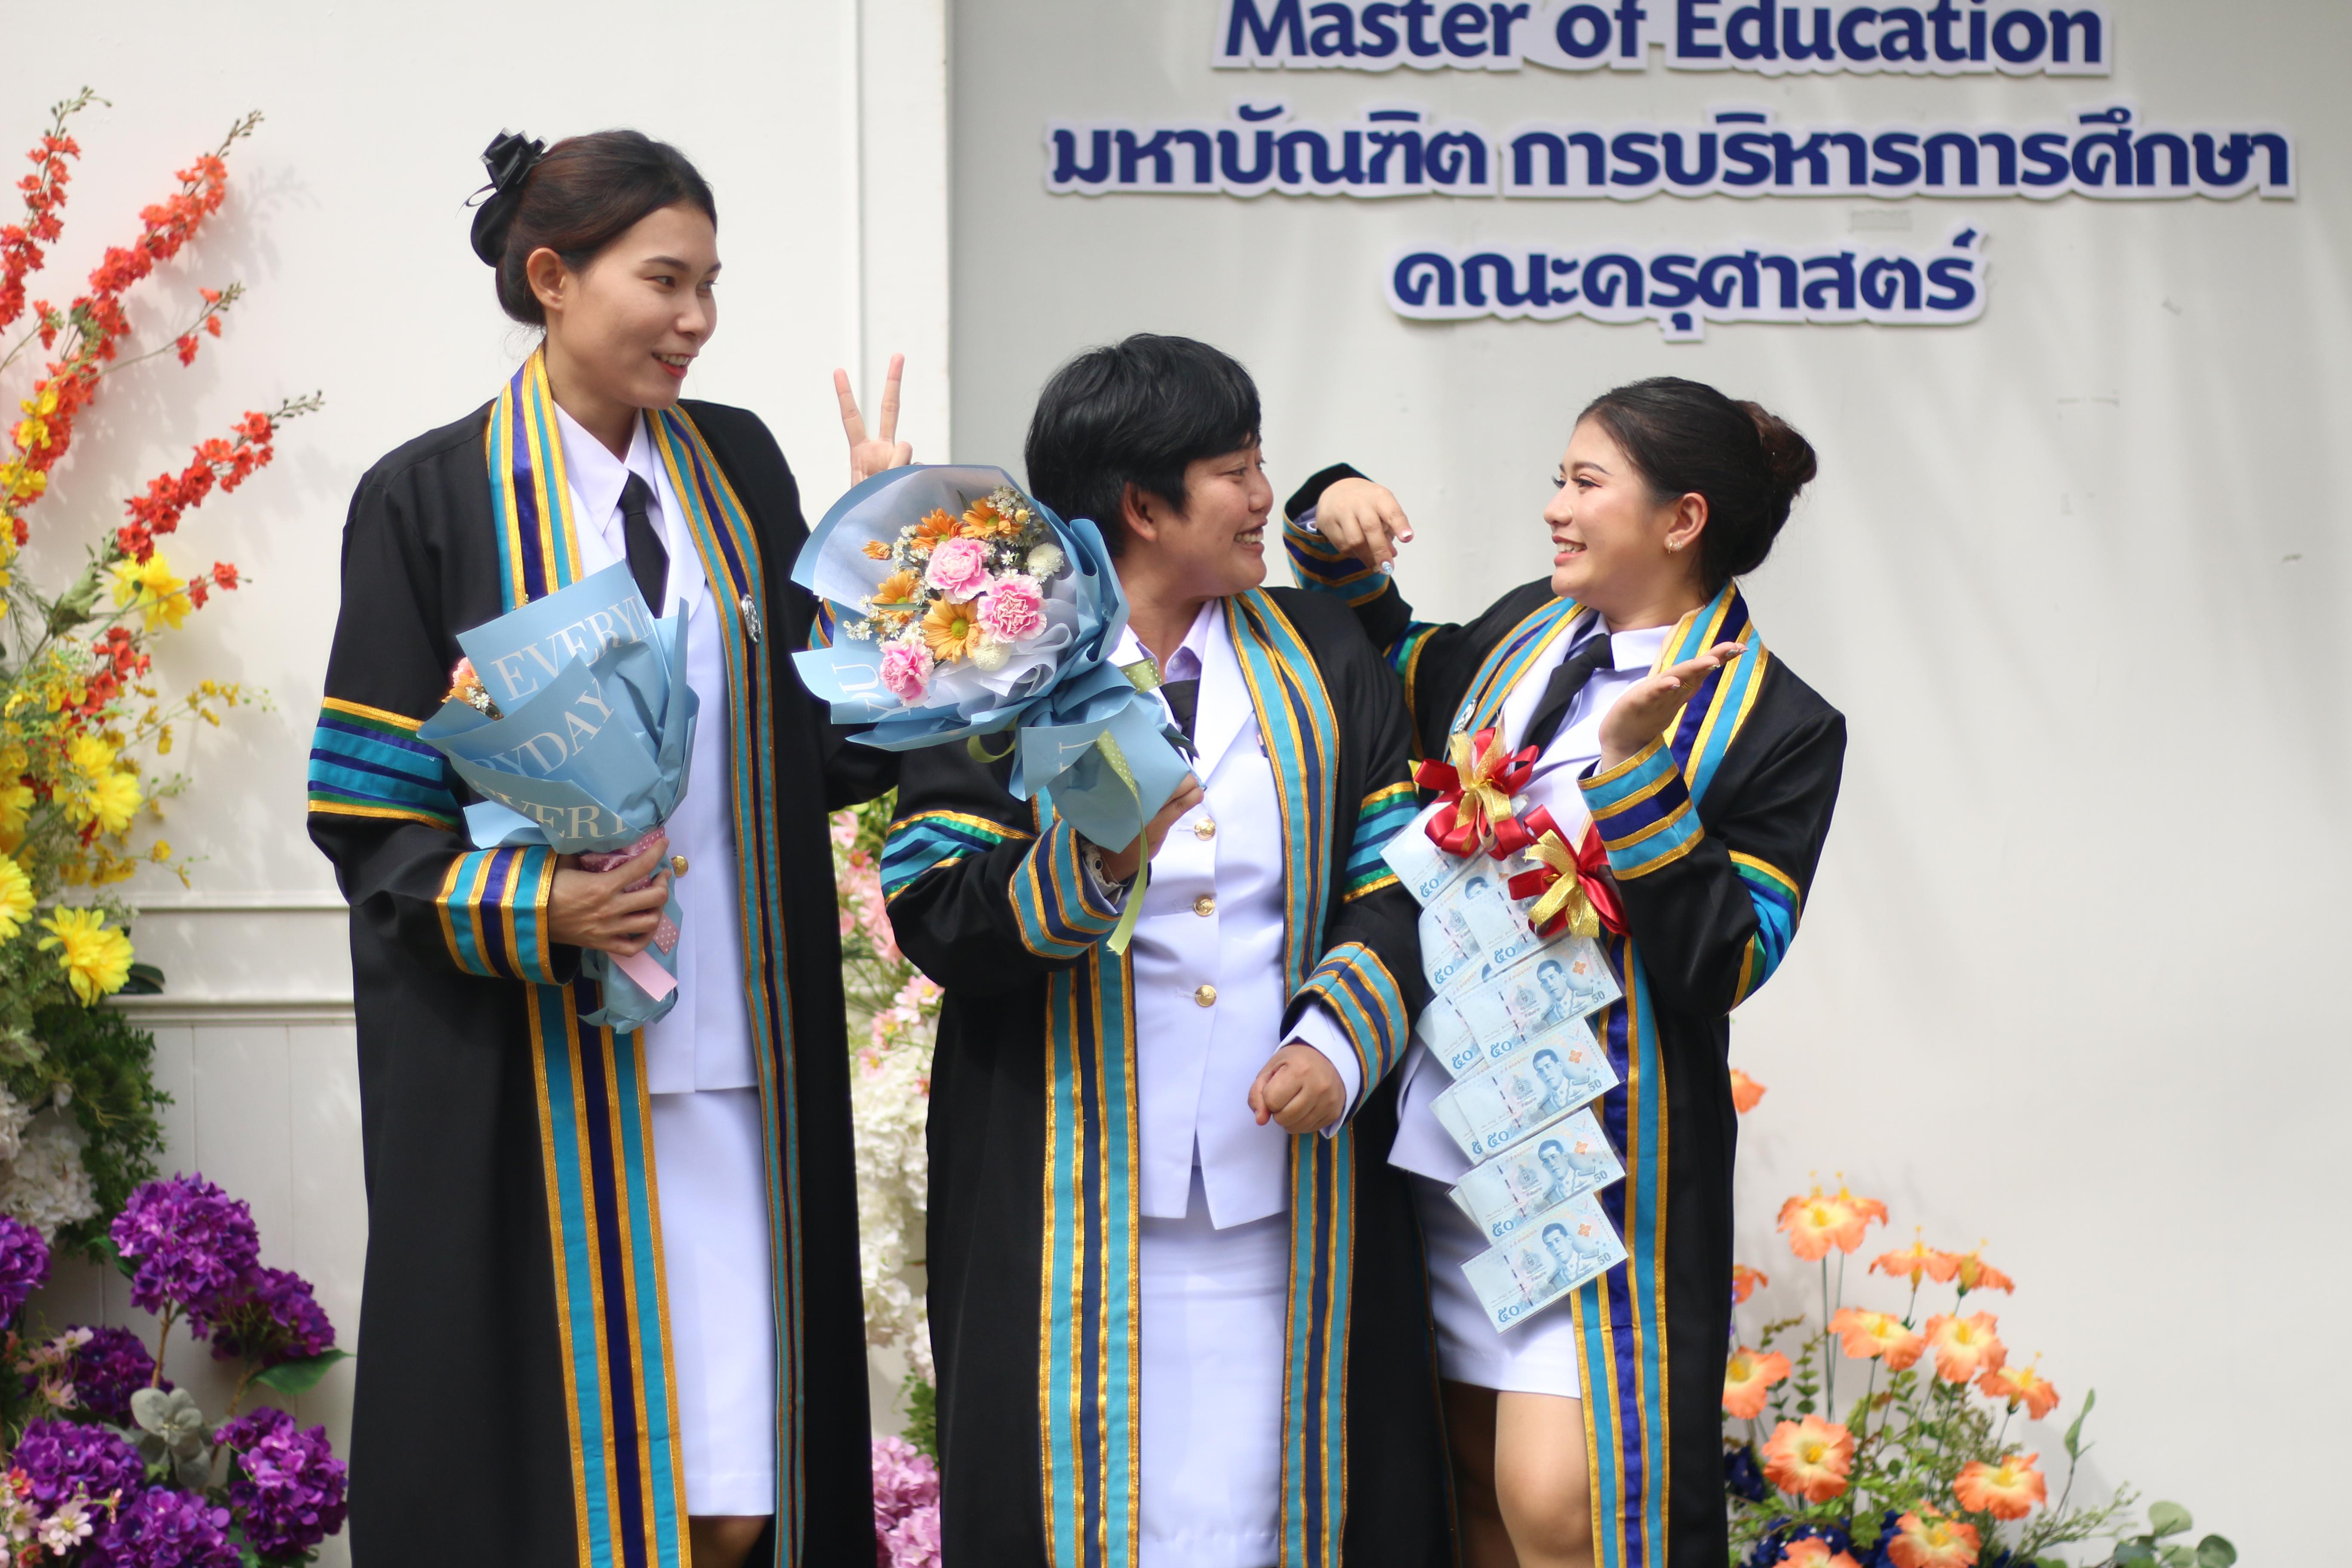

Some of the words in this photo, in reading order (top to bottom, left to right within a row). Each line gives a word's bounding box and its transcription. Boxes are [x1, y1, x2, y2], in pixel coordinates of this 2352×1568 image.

[1225, 0, 1530, 58] Master
[1556, 0, 1647, 58] of
[1677, 0, 2101, 63] Education
[1054, 105, 1487, 184] มหาบัณฑิต
[1511, 107, 2288, 187] การบริหารการศึกษา
[1394, 229, 1977, 331] คณะครุศาสตร์
[1592, 990, 1605, 1003] 50
[1588, 1079, 1602, 1092] 50
[1594, 1170, 1608, 1182] 50
[1598, 1253, 1611, 1265] 50
